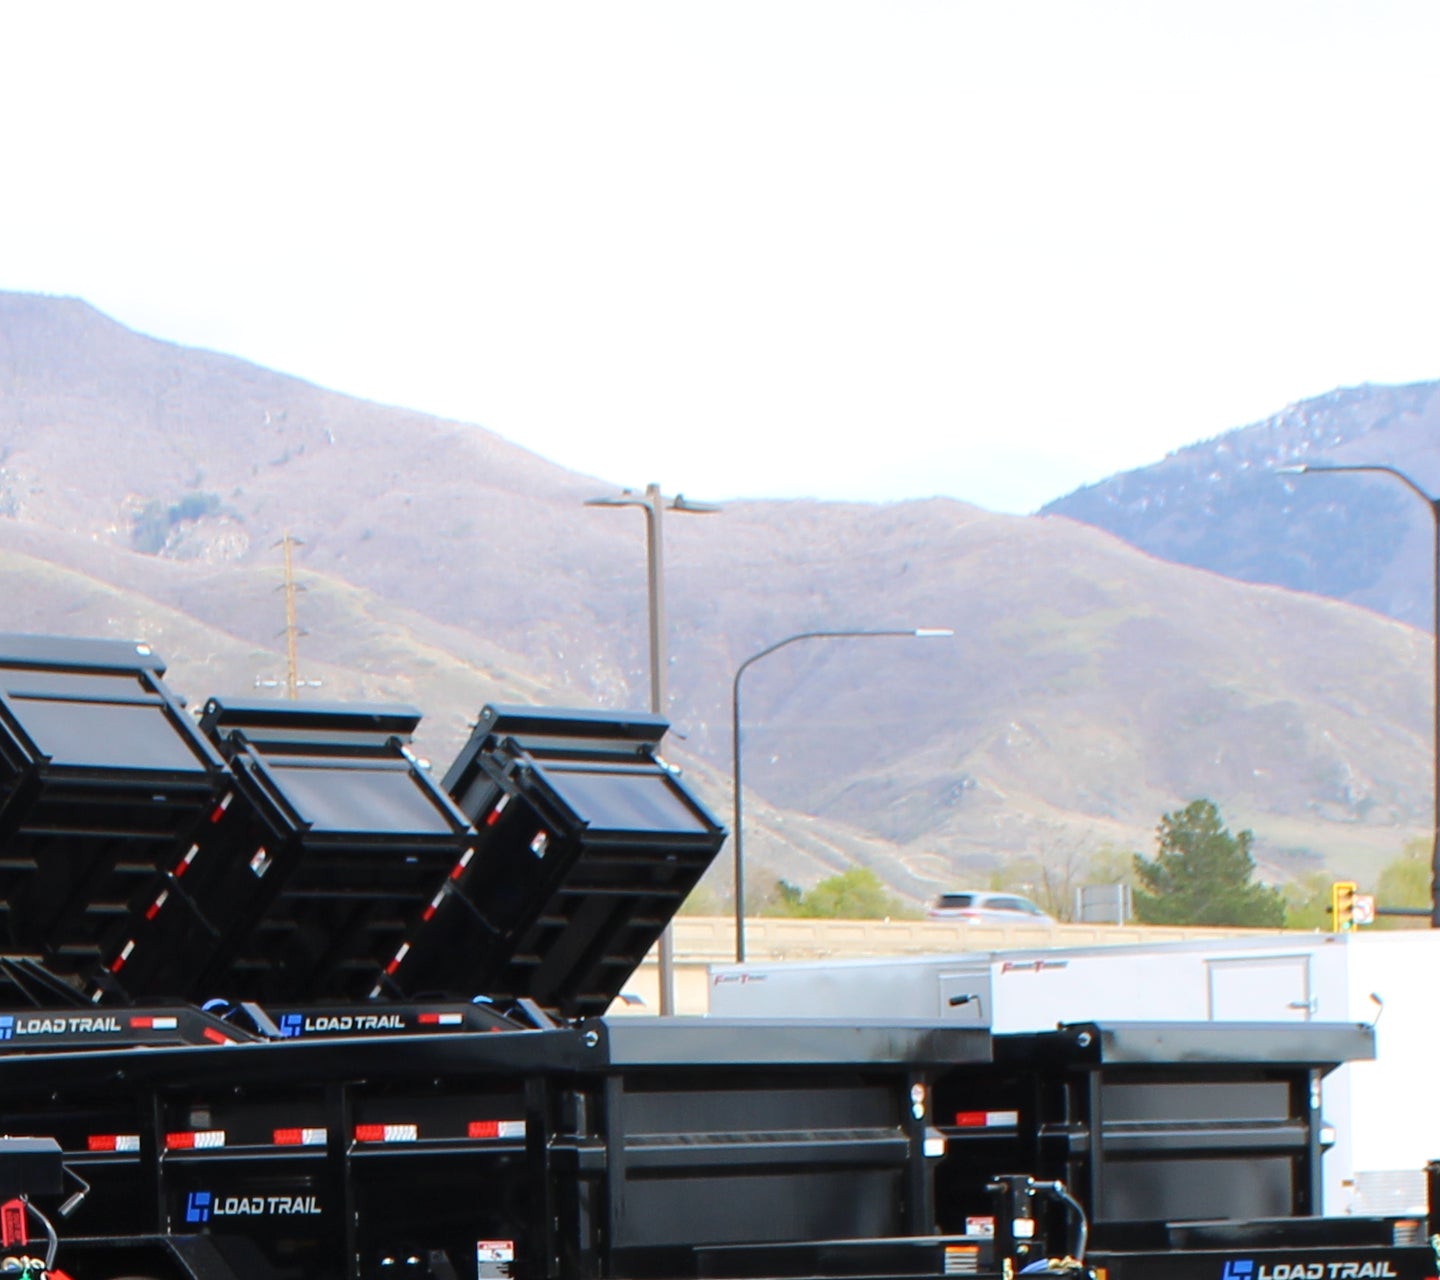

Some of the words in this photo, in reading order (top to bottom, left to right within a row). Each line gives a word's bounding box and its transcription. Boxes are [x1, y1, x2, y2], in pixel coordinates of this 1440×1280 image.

[16, 1019, 66, 1035] LOAD
[69, 1016, 122, 1033] TRAIL
[304, 1017, 352, 1032] LOAD
[355, 1014, 406, 1030] TRAIL
[213, 1197, 265, 1216] LOAD
[267, 1196, 322, 1215] TRAIL
[1327, 1261, 1398, 1279] TRAIL
